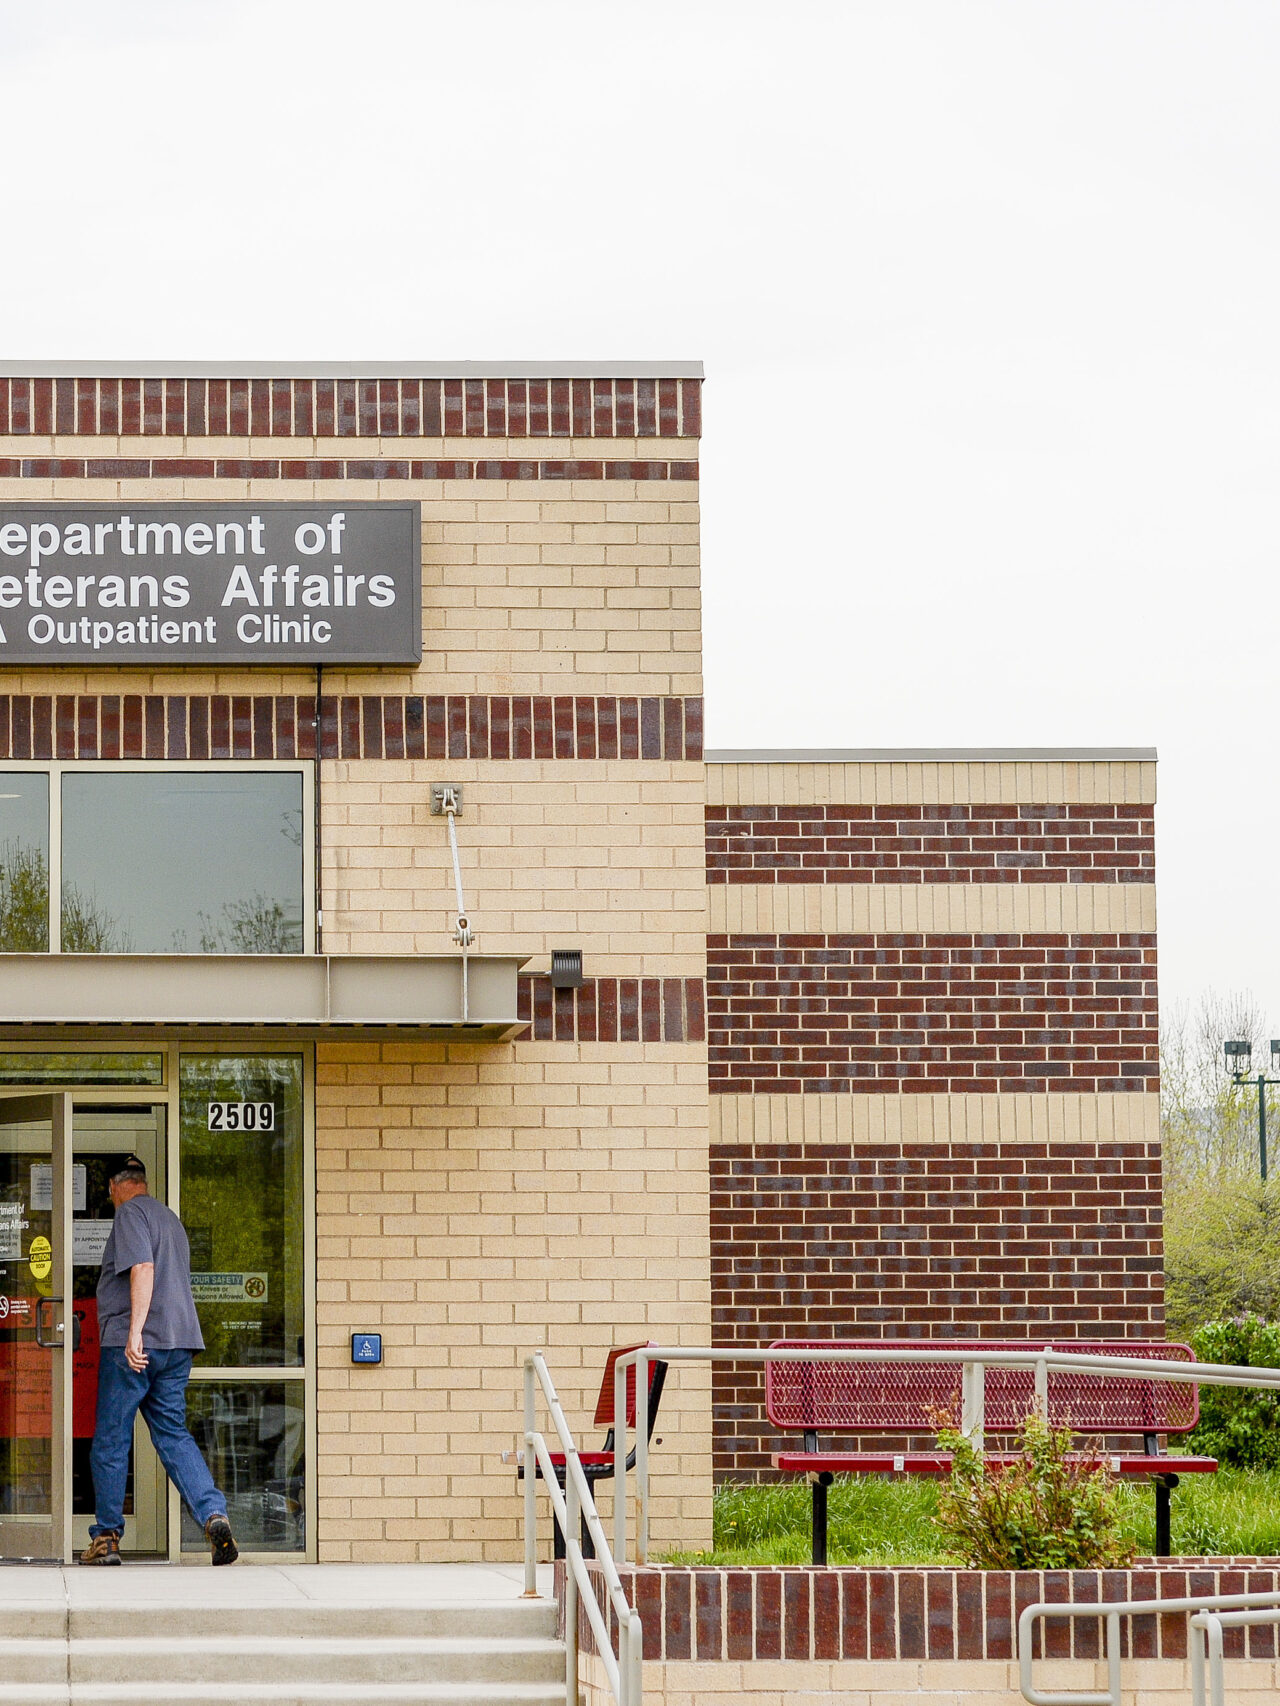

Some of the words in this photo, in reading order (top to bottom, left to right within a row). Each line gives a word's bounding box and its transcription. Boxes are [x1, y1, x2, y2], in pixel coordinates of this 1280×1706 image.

[294, 512, 347, 555] of
[221, 564, 397, 608] Affairs
[27, 614, 218, 649] Outpatient
[236, 613, 332, 644] Clinic
[210, 1103, 272, 1130] 2509
[18, 1203, 25, 1214] of
[10, 1219, 30, 1230] Affairs
[30, 1253, 51, 1262] CAUTION
[211, 1275, 241, 1284] SAFETY
